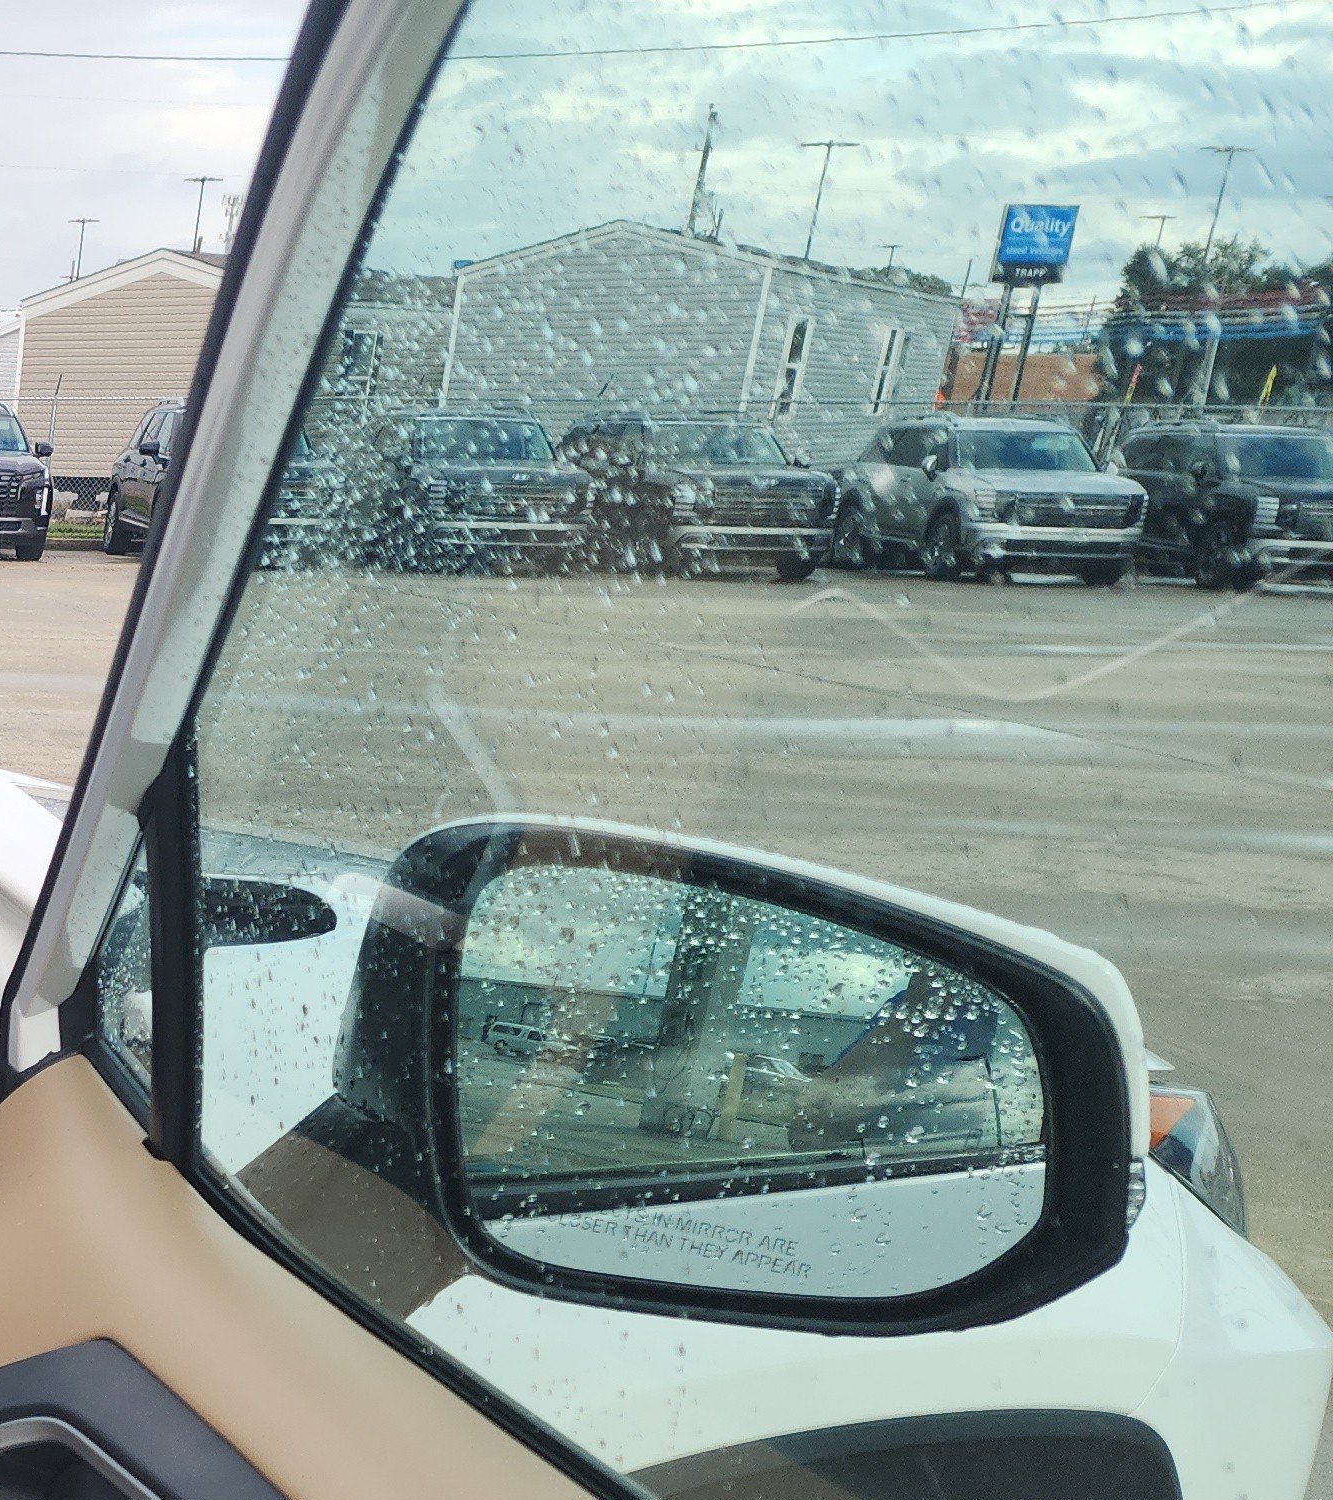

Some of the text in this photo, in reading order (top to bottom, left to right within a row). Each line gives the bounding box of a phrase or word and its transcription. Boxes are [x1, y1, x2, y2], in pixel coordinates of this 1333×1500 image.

[1010, 216, 1072, 238] Quality
[1014, 267, 1047, 278] TRAPP
[621, 1225, 673, 1249] THAN
[680, 1236, 730, 1260] THEY
[730, 1249, 812, 1279] APPEAR
[674, 1216, 753, 1246] MIRROR
[758, 1235, 799, 1257] ARE
